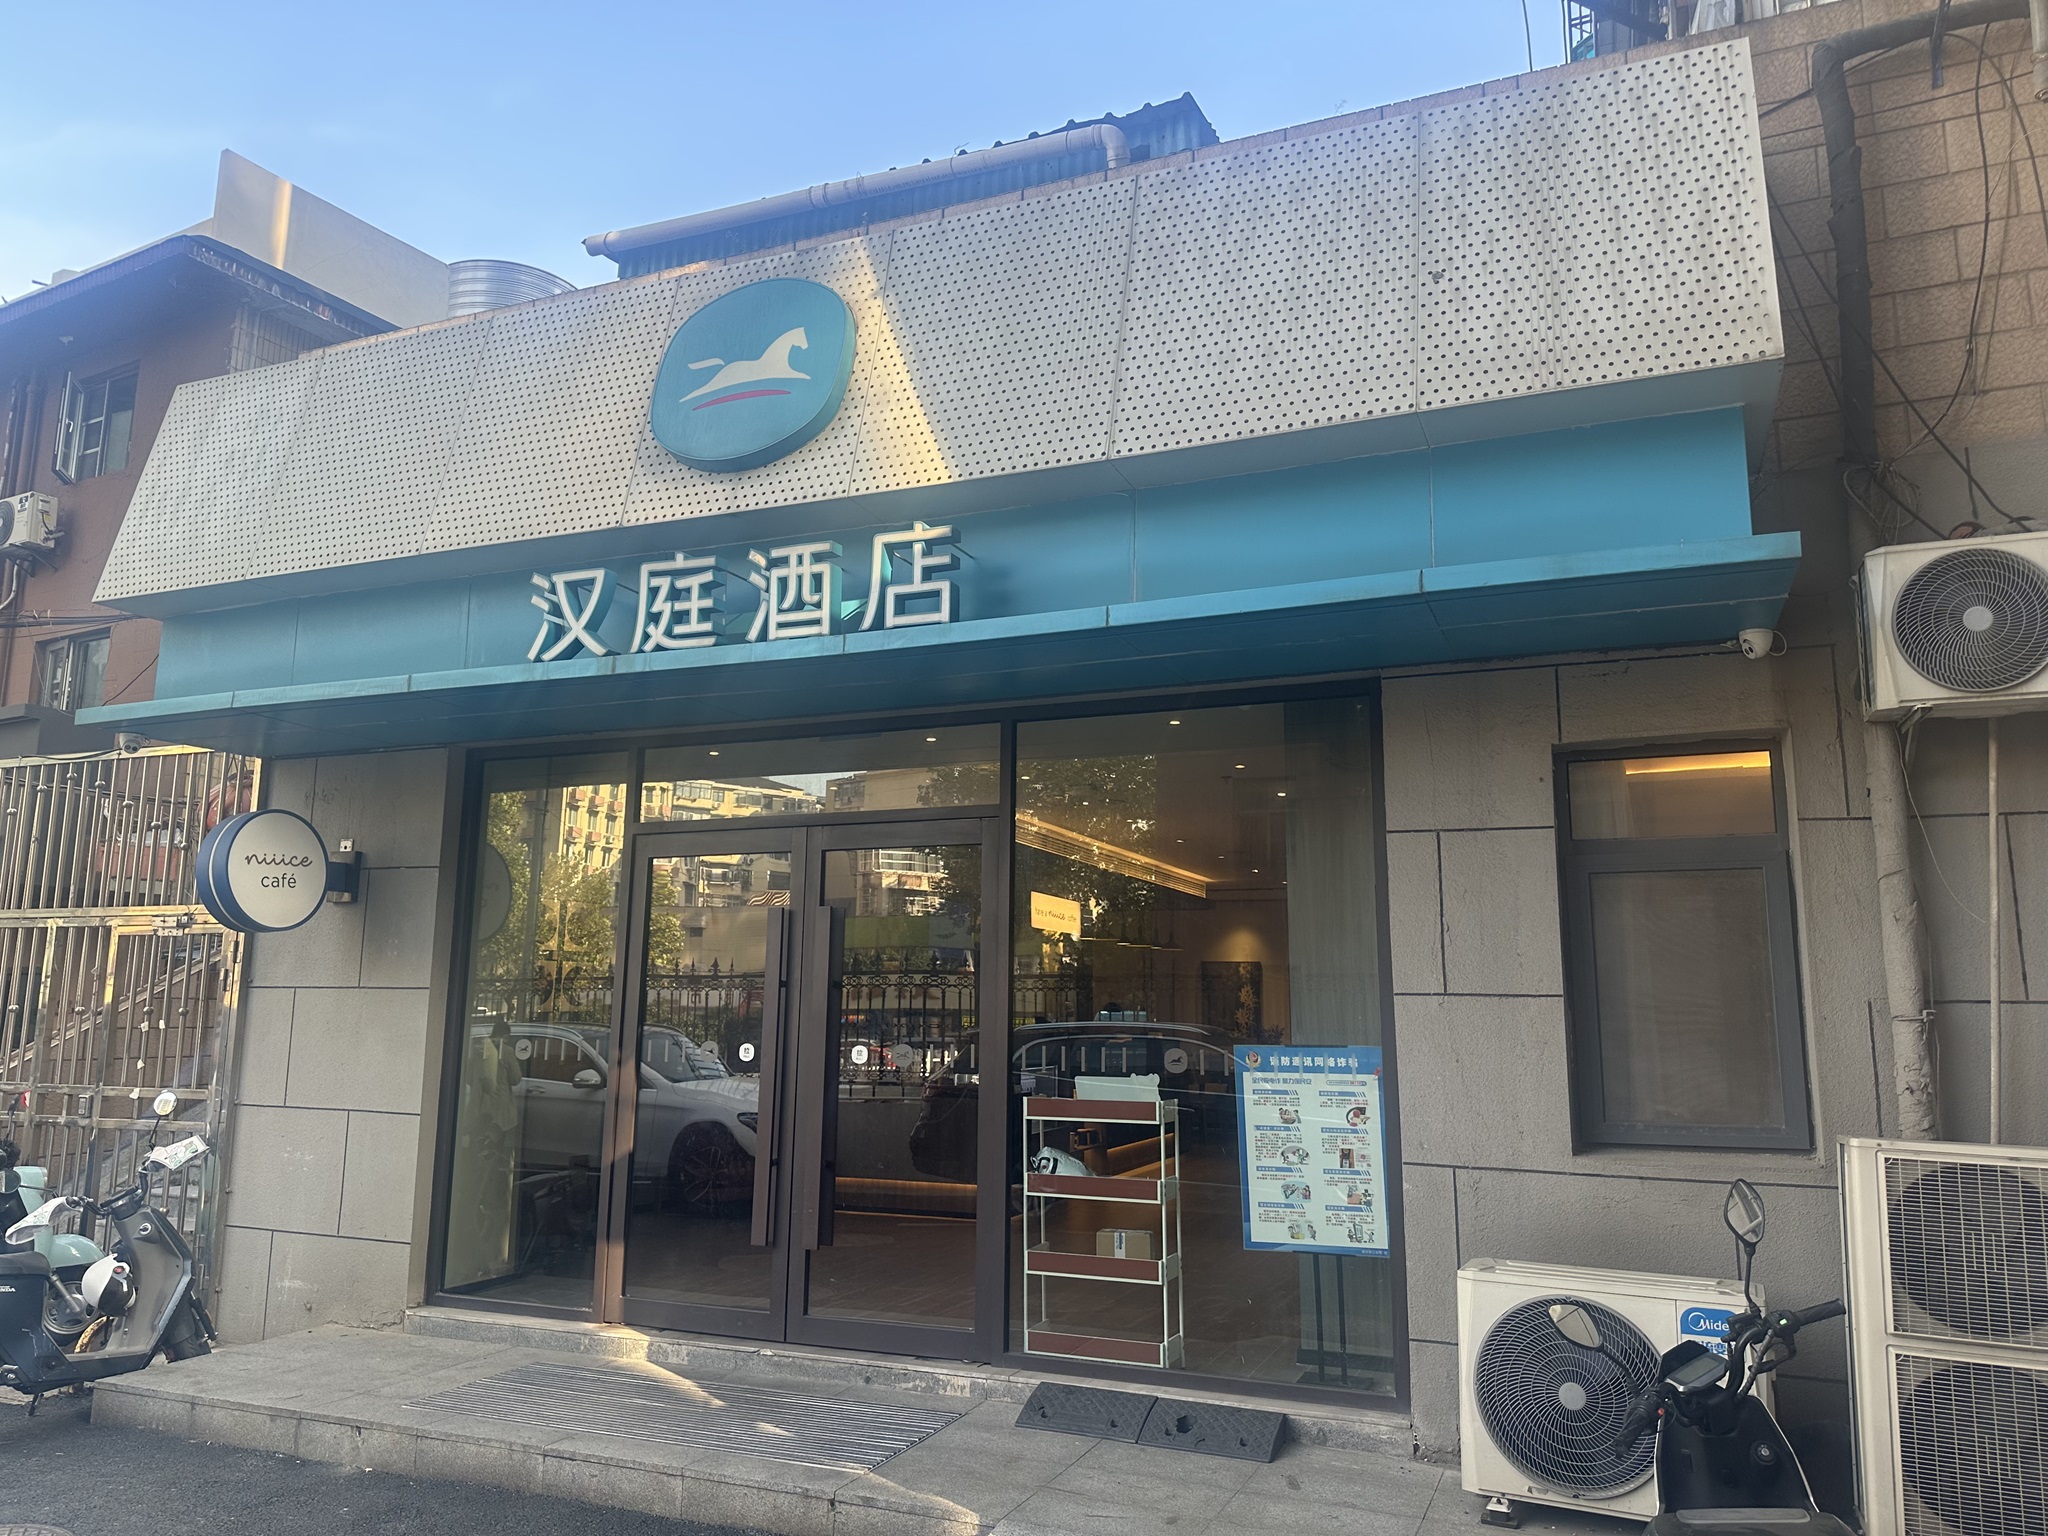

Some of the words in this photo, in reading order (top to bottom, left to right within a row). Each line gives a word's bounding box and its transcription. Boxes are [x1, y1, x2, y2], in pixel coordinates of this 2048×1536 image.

[527, 520, 957, 662] 汉庭酒店
[245, 852, 313, 868] niiice
[261, 873, 297, 889] café
[1689, 1314, 1729, 1331] Mide
